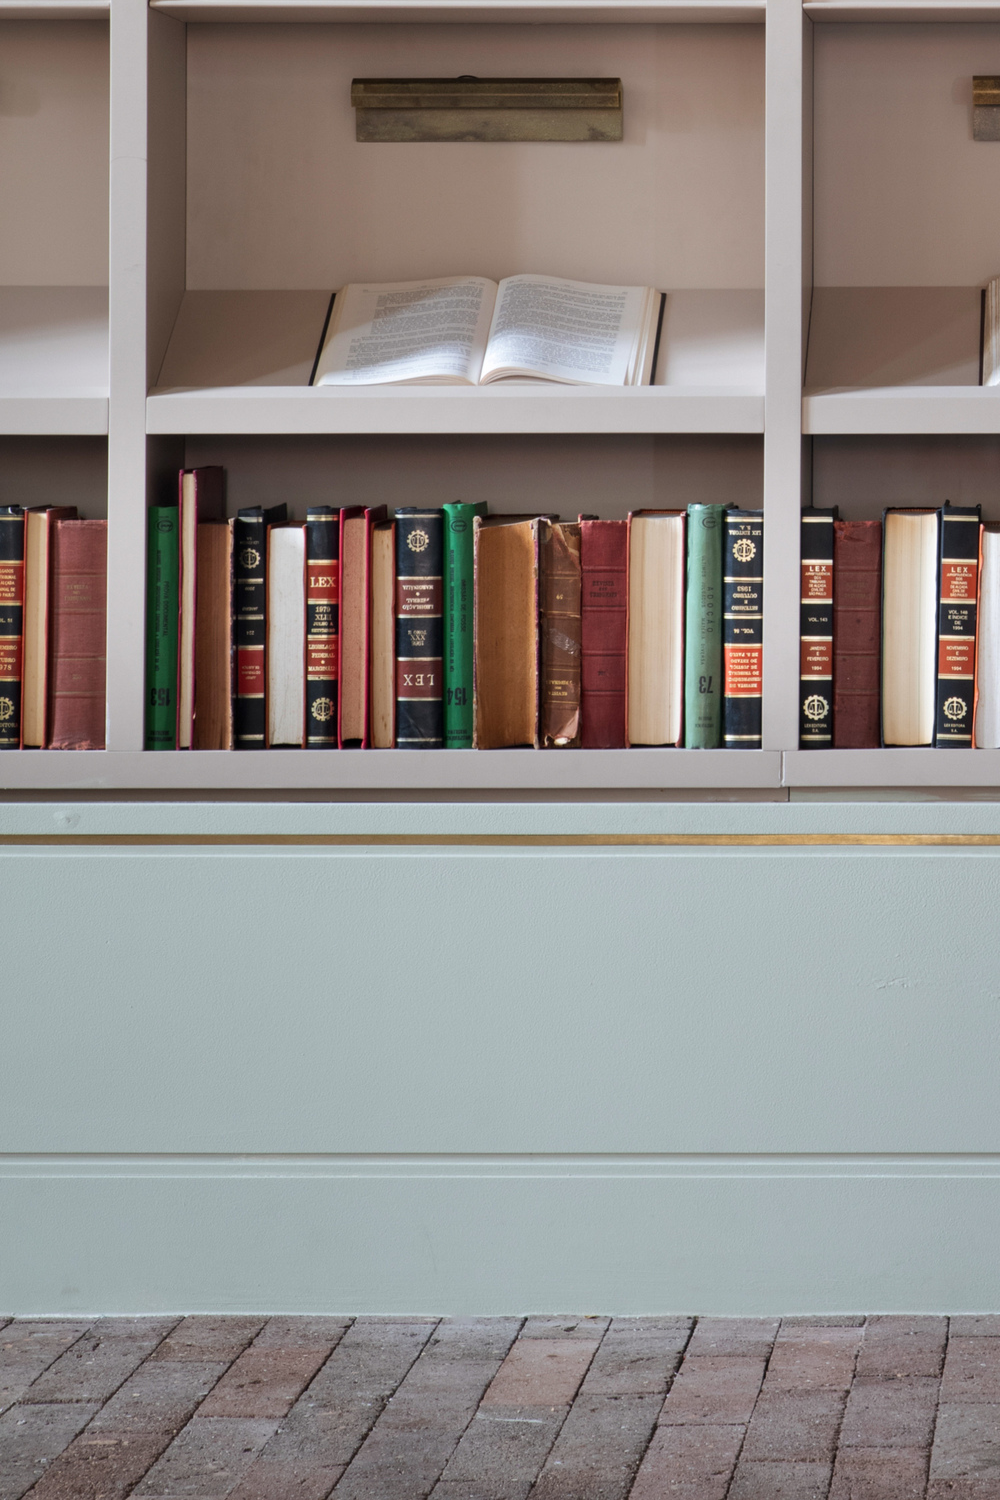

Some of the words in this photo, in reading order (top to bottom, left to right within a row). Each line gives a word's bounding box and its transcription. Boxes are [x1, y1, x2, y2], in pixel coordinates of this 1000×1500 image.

[310, 577, 336, 588] LEX
[403, 673, 435, 686] LEX
[698, 675, 714, 694] 73
